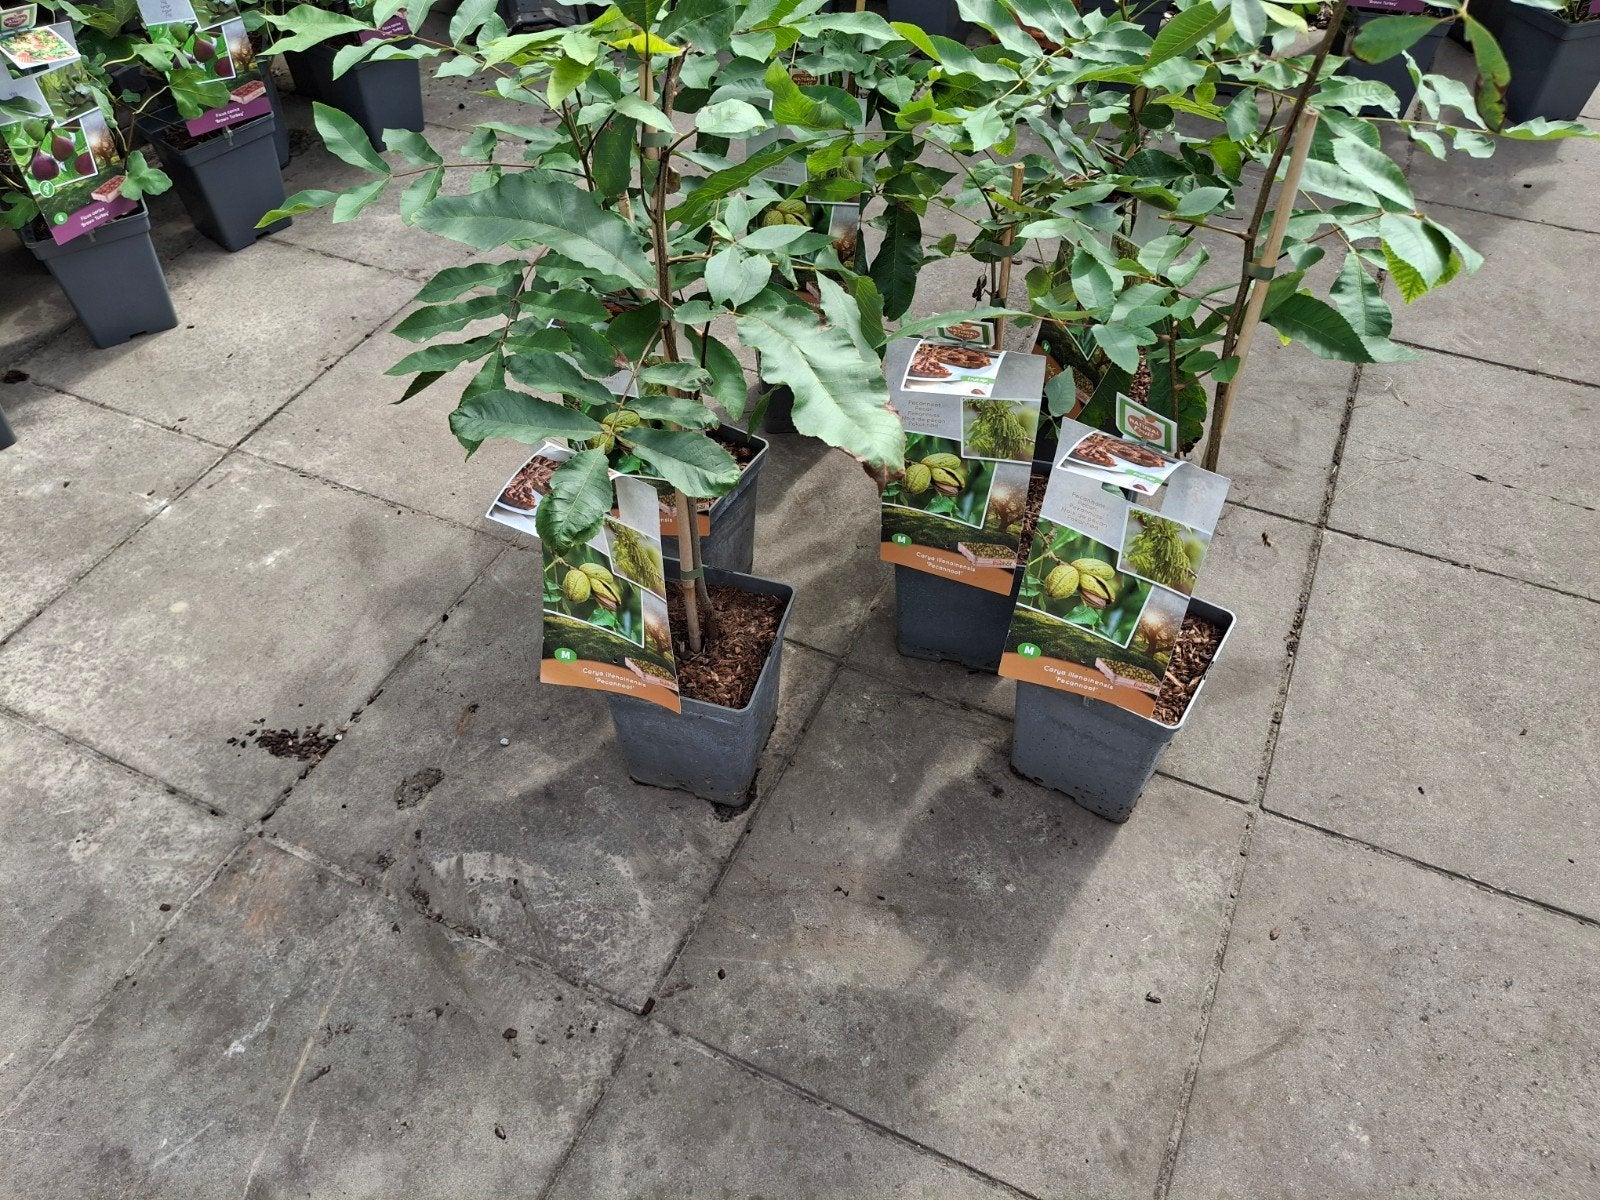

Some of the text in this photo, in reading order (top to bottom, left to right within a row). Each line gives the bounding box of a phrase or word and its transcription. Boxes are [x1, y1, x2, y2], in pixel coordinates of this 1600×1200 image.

[1128, 416, 1161, 436] NATURAL
[897, 535, 906, 544] M
[916, 551, 935, 561] Carya
[560, 650, 571, 660] M
[1024, 645, 1034, 656] M
[582, 667, 604, 677] Carya
[1043, 665, 1066, 676] Carya
